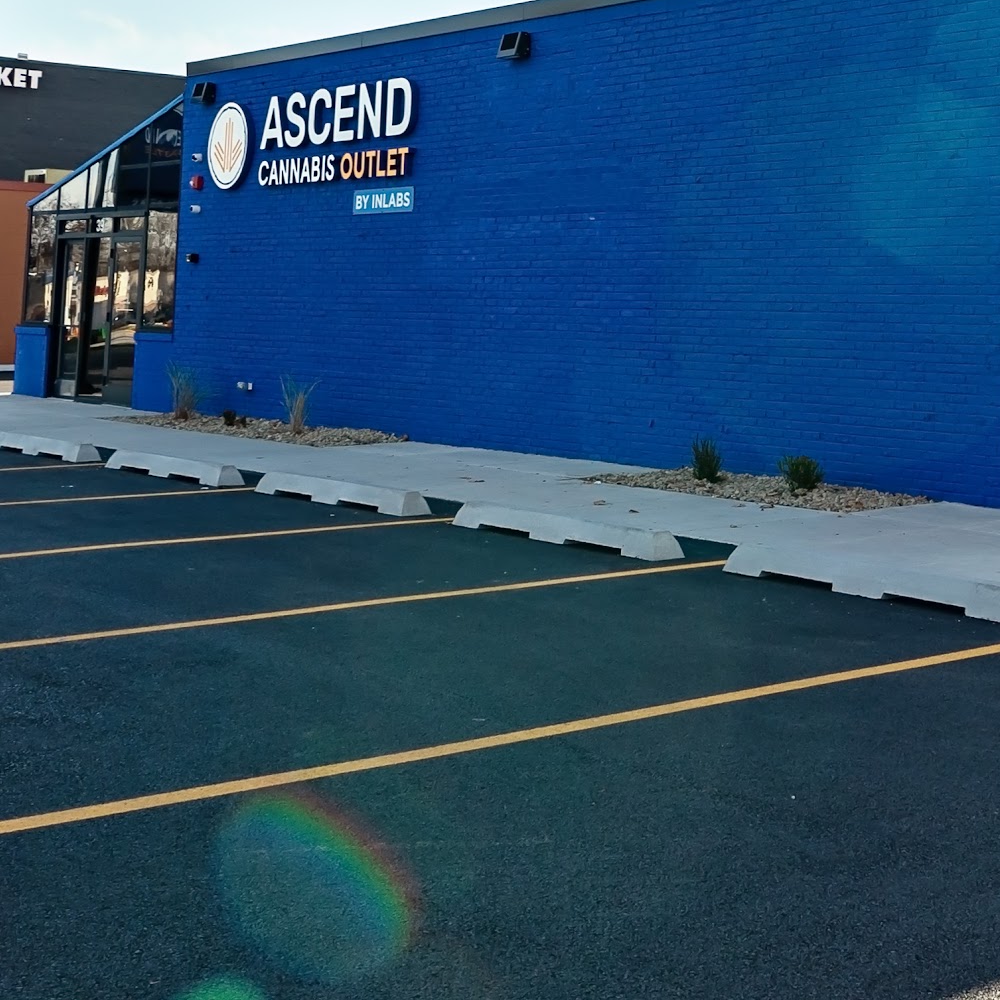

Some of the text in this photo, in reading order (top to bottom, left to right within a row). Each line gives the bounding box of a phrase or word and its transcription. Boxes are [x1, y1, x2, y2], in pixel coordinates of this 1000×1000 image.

[260, 77, 412, 150] ASCEND
[258, 147, 409, 186] CANNABIS OUTLET
[355, 192, 411, 210] BY INLABS
